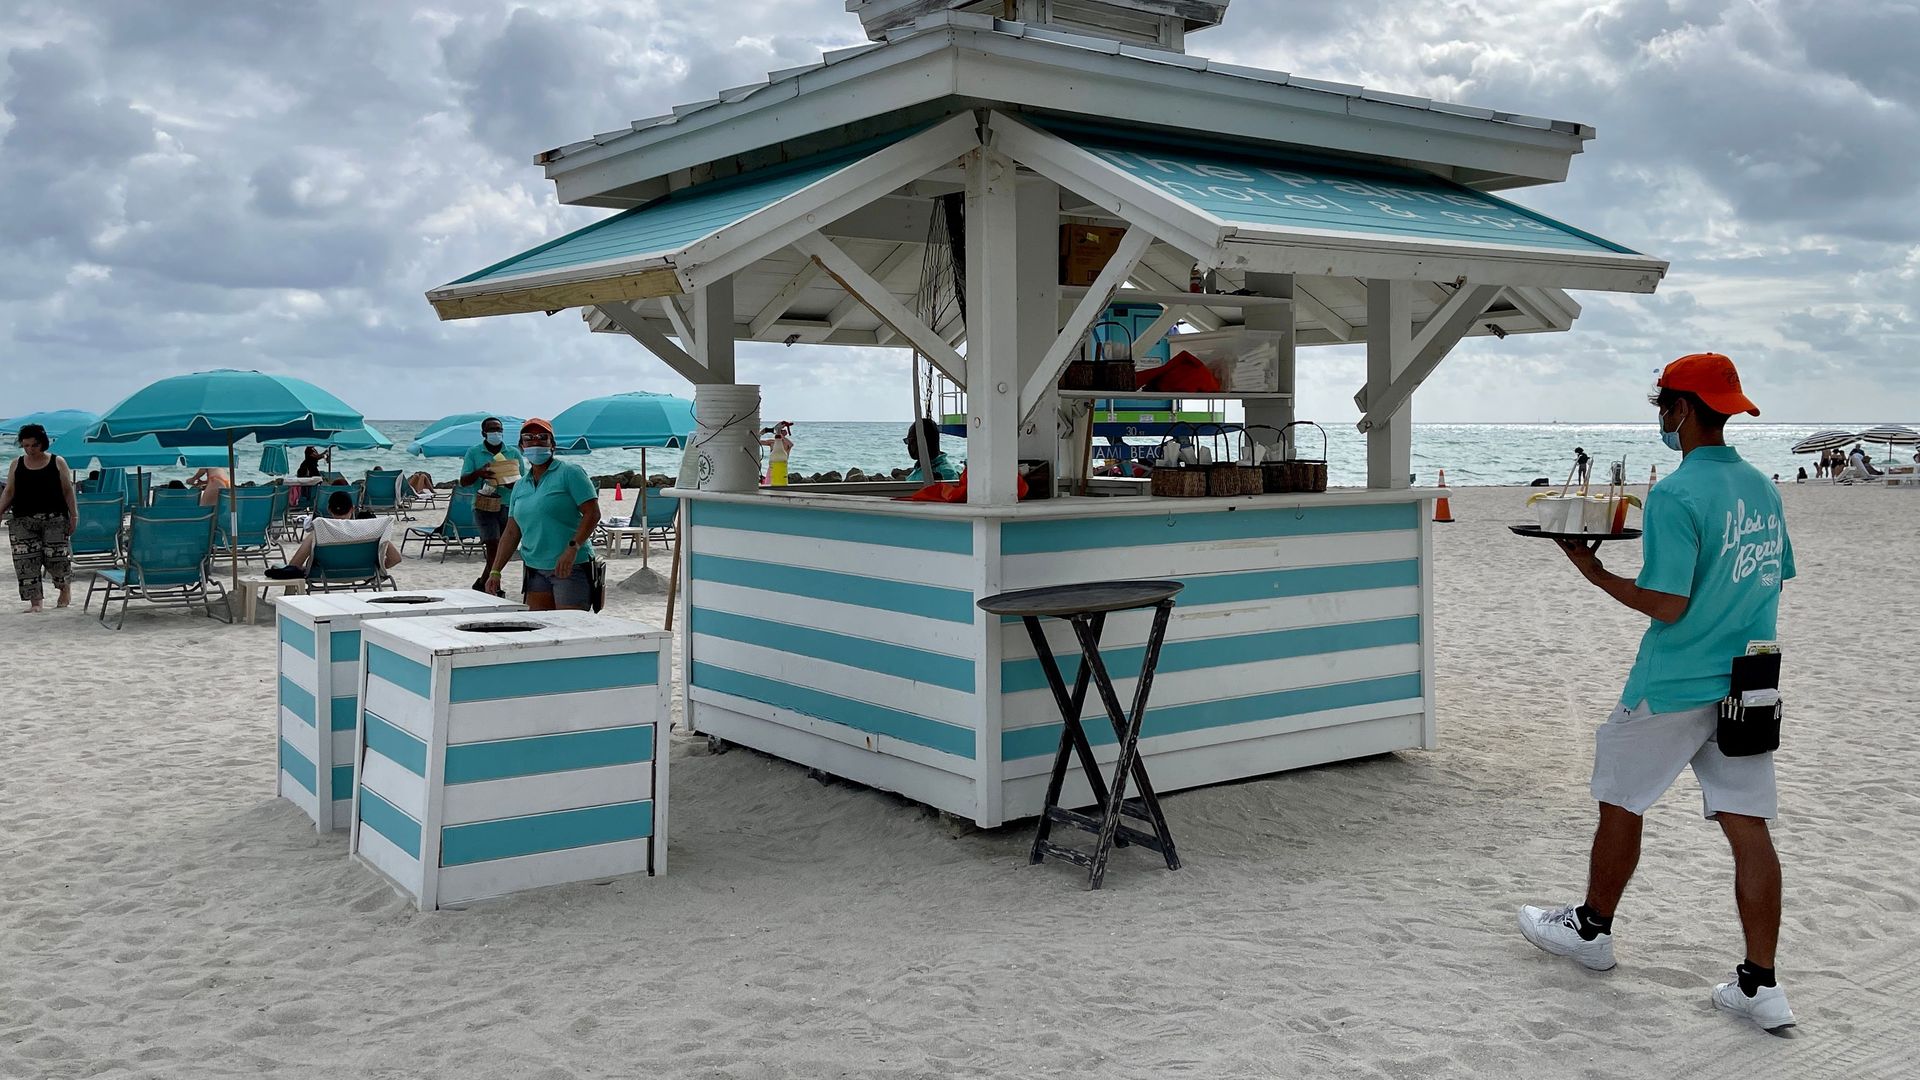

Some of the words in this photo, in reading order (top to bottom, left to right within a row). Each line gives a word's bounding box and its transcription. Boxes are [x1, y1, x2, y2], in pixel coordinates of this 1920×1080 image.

[1084, 147, 1255, 183] The
[1146, 175, 1353, 212] hotel
[1367, 200, 1429, 220] &
[1440, 210, 1556, 232] spa
[1092, 446, 1122, 459] IAMI
[1130, 446, 1163, 459] BEAC
[1125, 426, 1137, 436] 30
[1720, 498, 1765, 557] Life's
[1767, 513, 1778, 530] a
[1732, 519, 1783, 584] Beach
